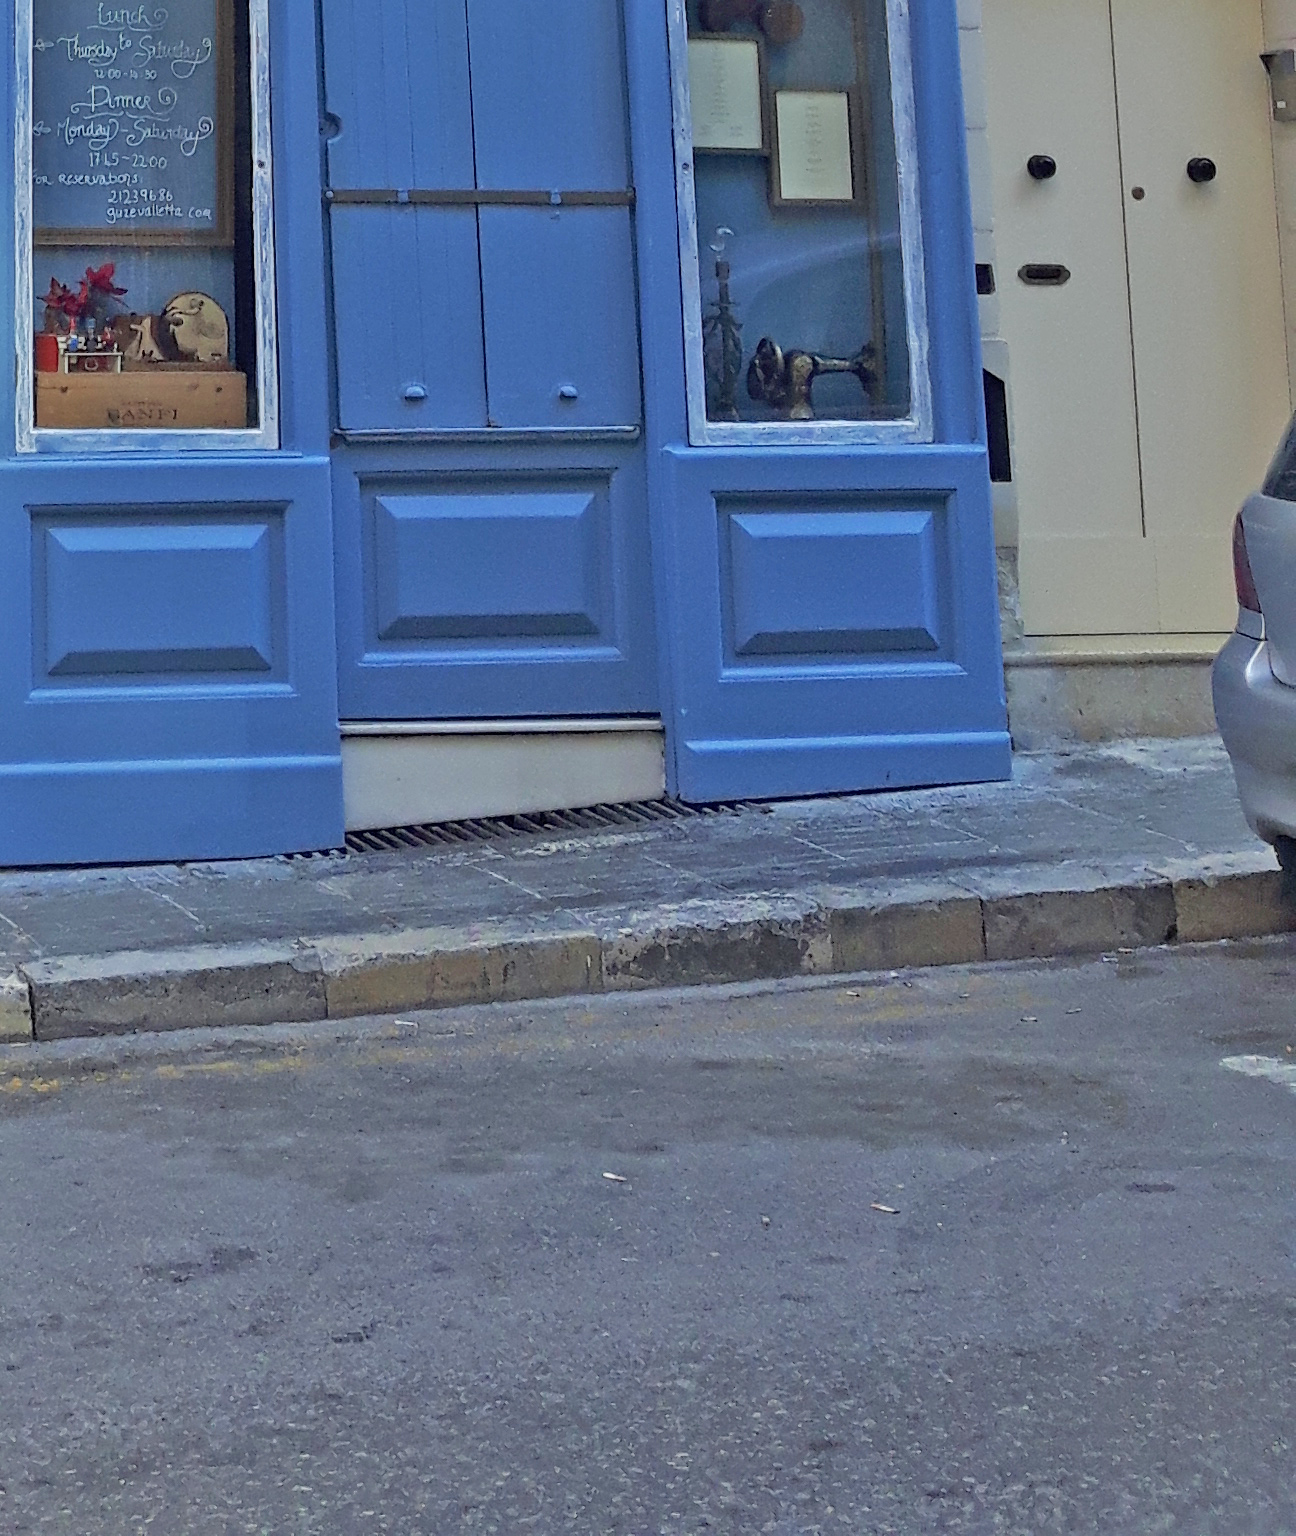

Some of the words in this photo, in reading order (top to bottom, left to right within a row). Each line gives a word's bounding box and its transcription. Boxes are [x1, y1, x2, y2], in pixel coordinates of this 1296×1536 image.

[97, 2, 169, 28] Lunch
[57, 33, 118, 66] Thursday
[119, 32, 132, 50] to
[71, 85, 177, 115] Dinner
[57, 117, 119, 151] Monday
[126, 116, 214, 157] Saturday
[108, 188, 173, 204] 21239686
